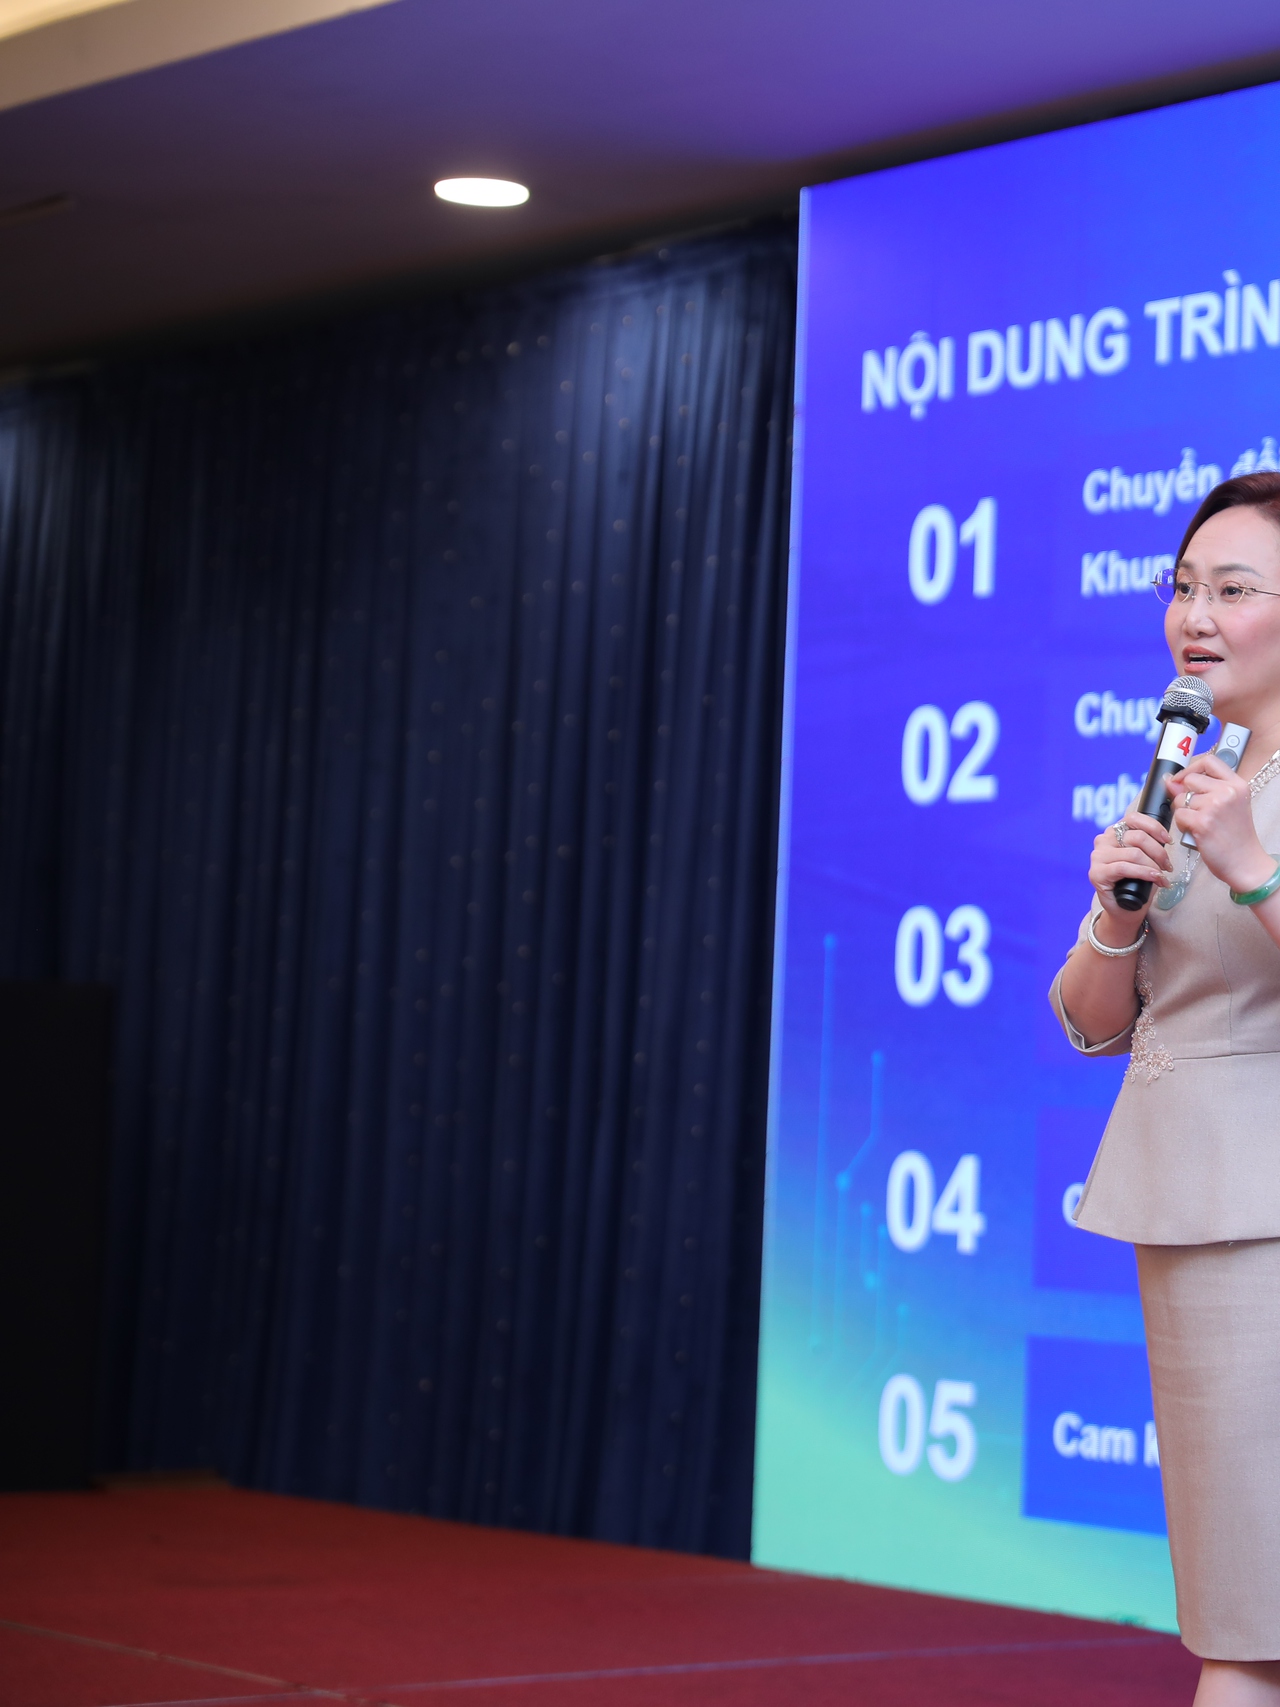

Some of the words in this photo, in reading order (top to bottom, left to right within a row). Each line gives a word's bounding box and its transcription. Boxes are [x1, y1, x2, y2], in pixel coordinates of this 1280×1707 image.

[862, 332, 953, 418] NỘI
[968, 308, 1128, 394] DUNG
[1083, 449, 1222, 514] Chuyển
[909, 498, 995, 603] 01
[1081, 551, 1175, 597] Khun
[902, 702, 997, 804] 02
[1075, 690, 1162, 742] Chuy
[1178, 736, 1192, 757] 4
[1073, 773, 1147, 830] ngh
[895, 906, 990, 1005] 03
[886, 1151, 984, 1254] 04
[878, 1375, 976, 1483] 05
[1053, 1413, 1136, 1463] Cam
